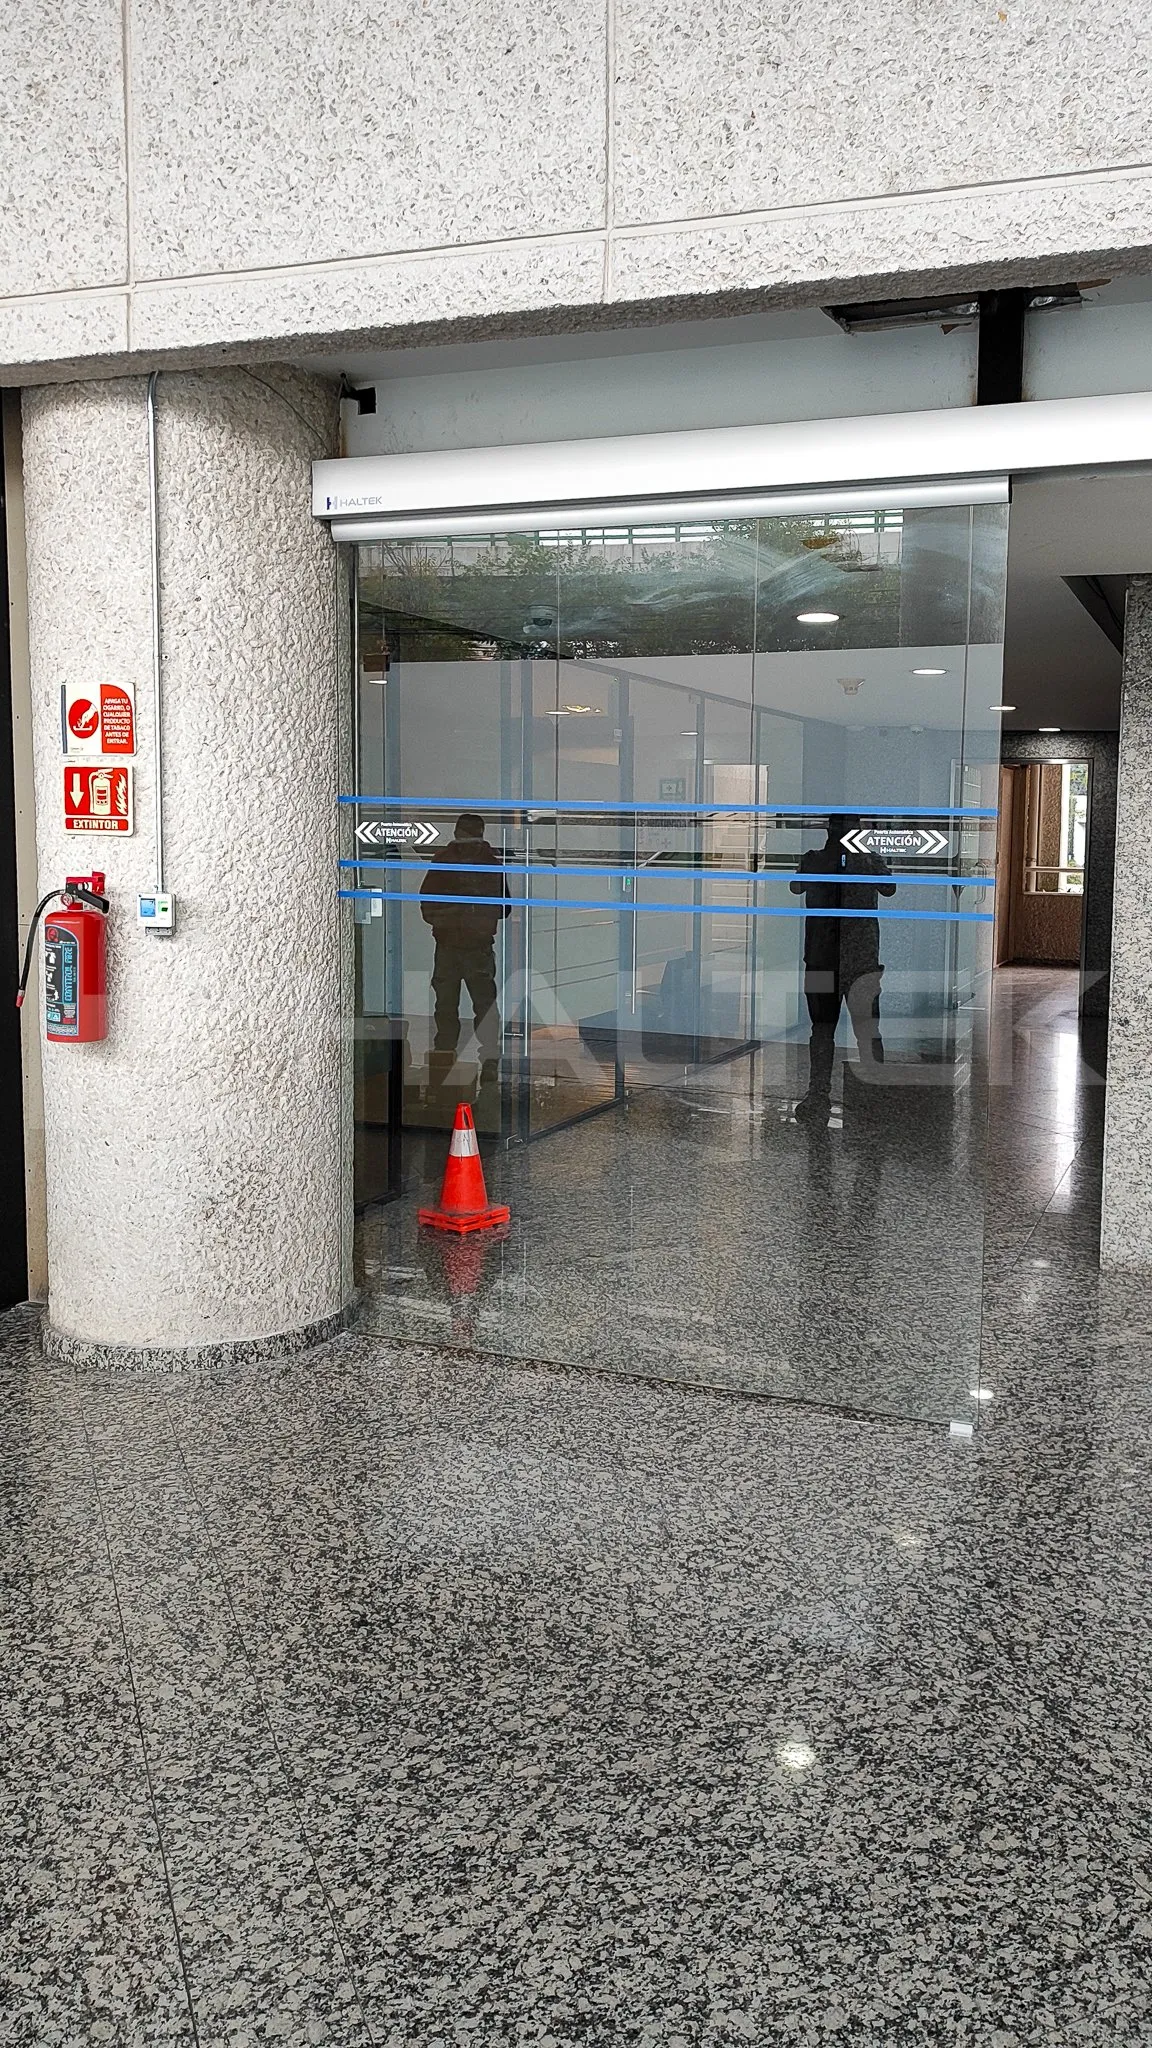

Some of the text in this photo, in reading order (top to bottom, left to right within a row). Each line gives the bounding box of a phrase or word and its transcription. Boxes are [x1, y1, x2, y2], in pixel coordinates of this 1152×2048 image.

[340, 496, 382, 507] HALTEK
[73, 819, 119, 830] EXTINTOR
[375, 826, 418, 837] ATENCIÓN
[866, 834, 921, 846] ATENCIÓN
[64, 947, 73, 963] FIRE
[64, 965, 73, 1001] CONTROL
